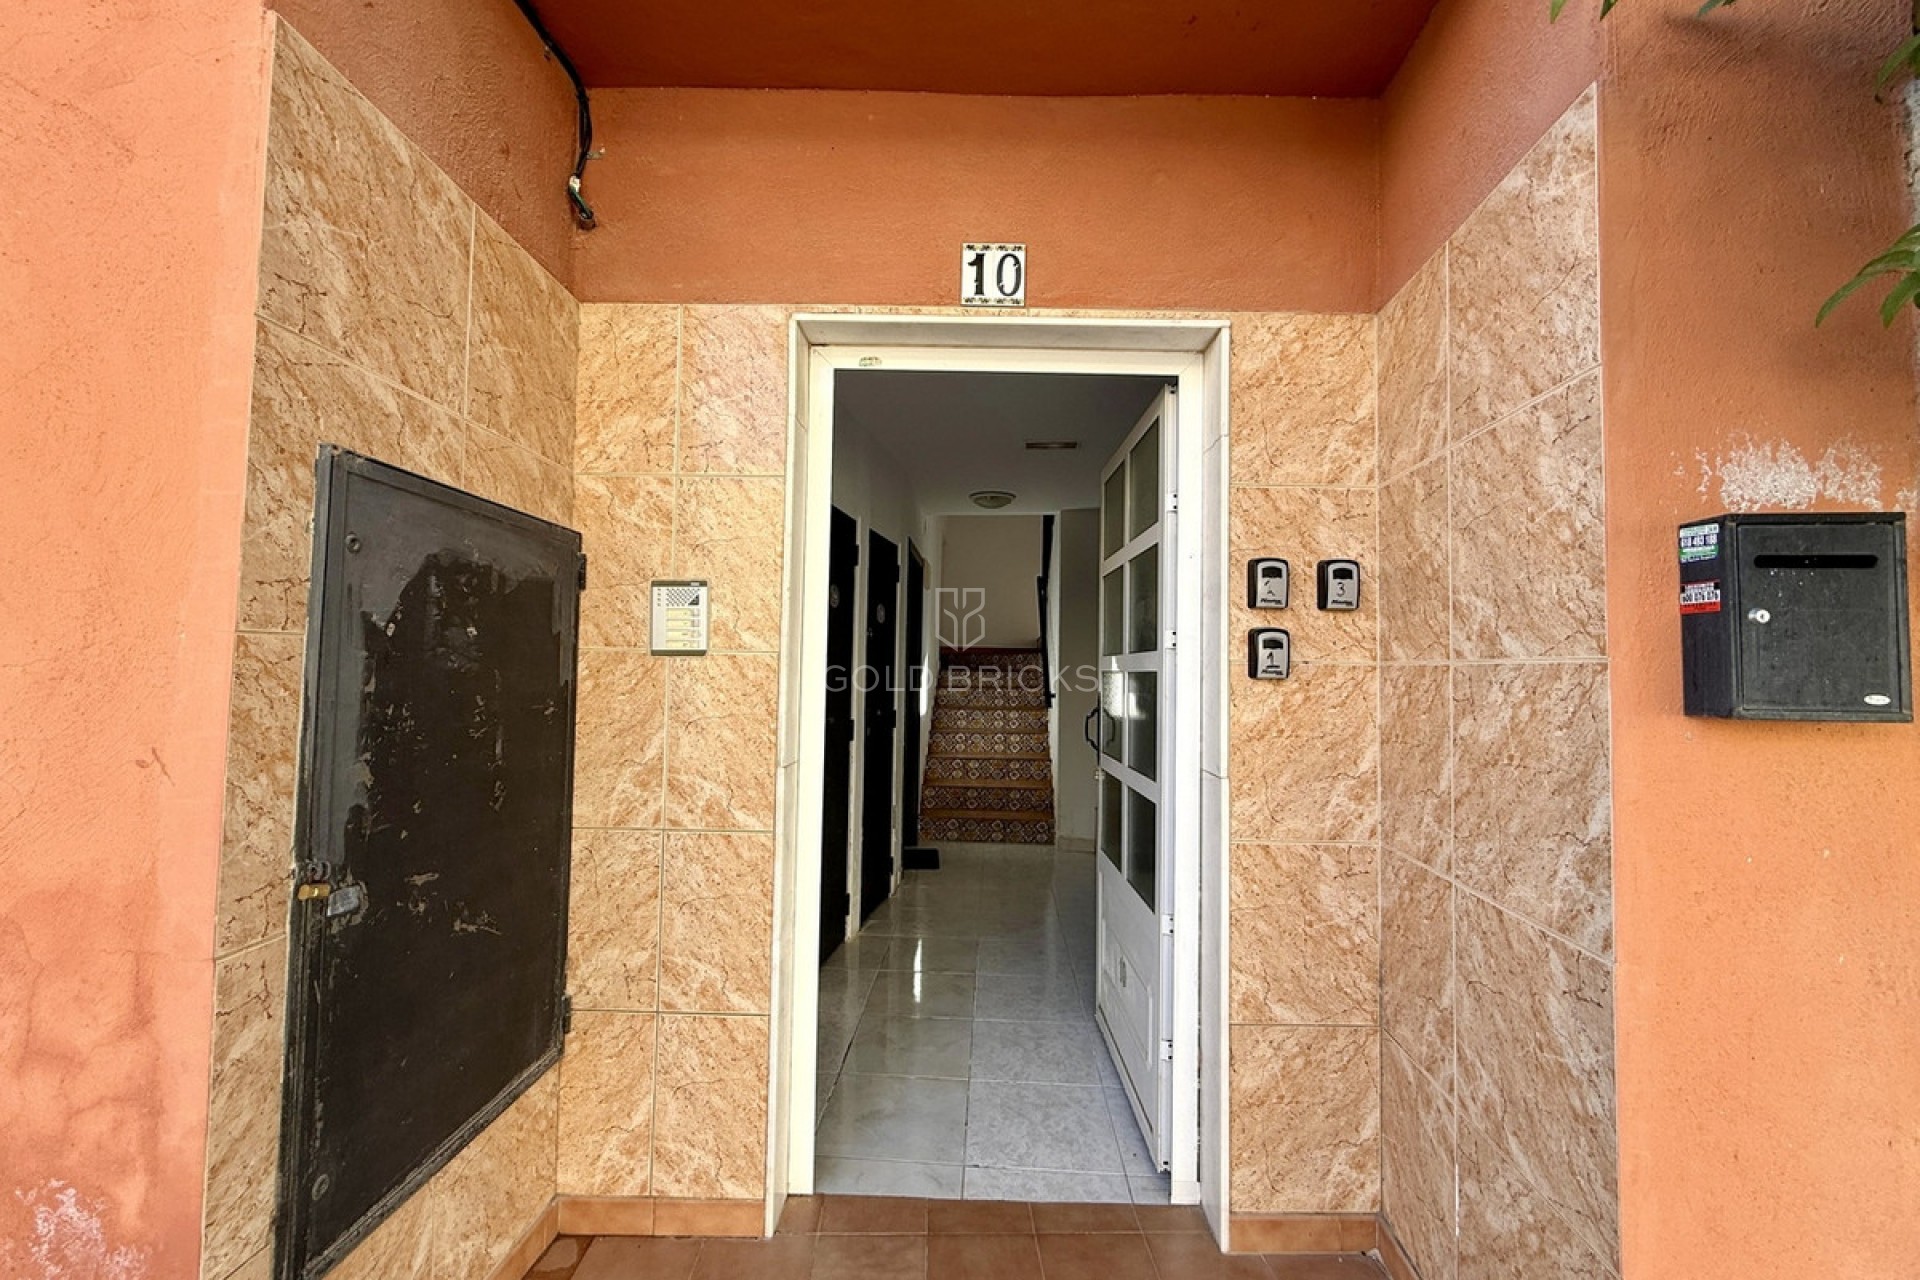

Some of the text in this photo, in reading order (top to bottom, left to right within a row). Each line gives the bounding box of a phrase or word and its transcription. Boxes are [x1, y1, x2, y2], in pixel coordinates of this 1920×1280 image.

[967, 252, 1022, 296] 10
[1337, 582, 1346, 597] 3
[1266, 651, 1280, 668] 1
